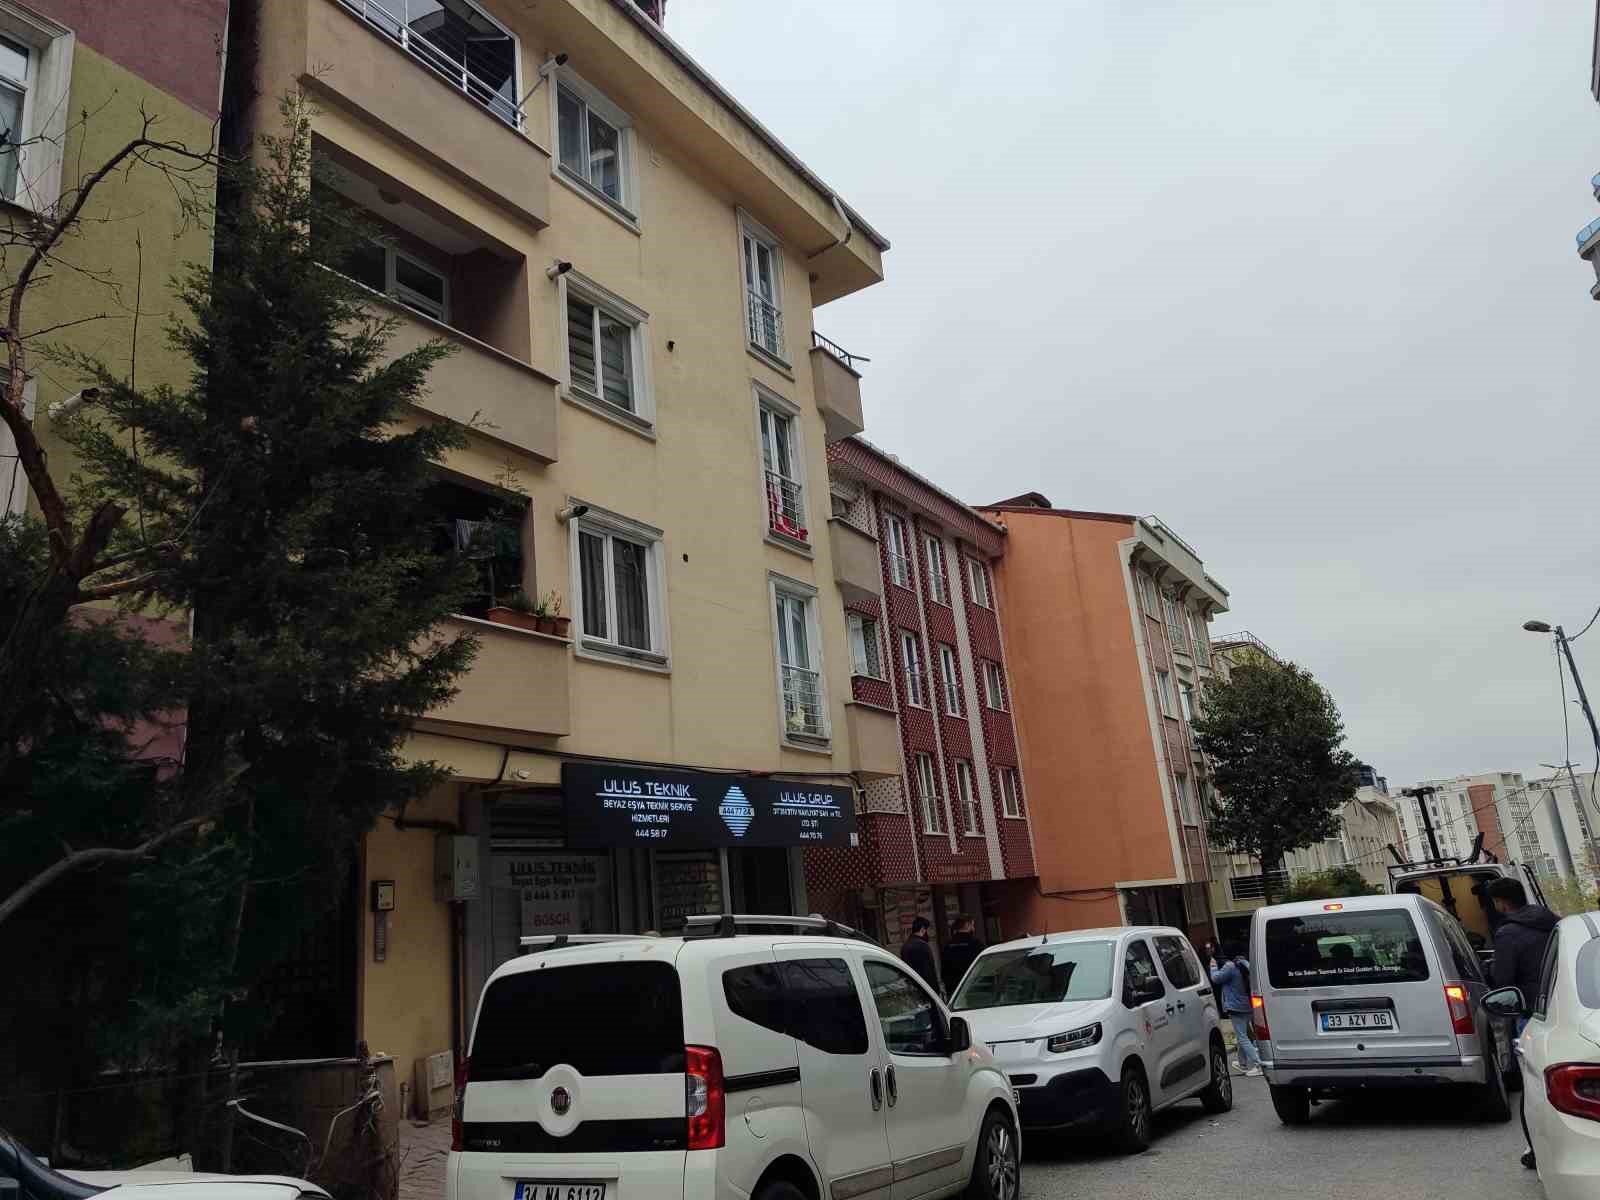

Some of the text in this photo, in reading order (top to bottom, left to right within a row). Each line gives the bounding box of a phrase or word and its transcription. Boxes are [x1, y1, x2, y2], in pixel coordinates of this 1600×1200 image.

[603, 779, 641, 794] ULUS
[780, 791, 806, 804] ULUS
[603, 799, 626, 809] BEYAZ
[635, 829, 649, 837] 444
[533, 912, 571, 927] BOSCH
[1329, 1015, 1342, 1026] 33
[1374, 1014, 1387, 1025] 06
